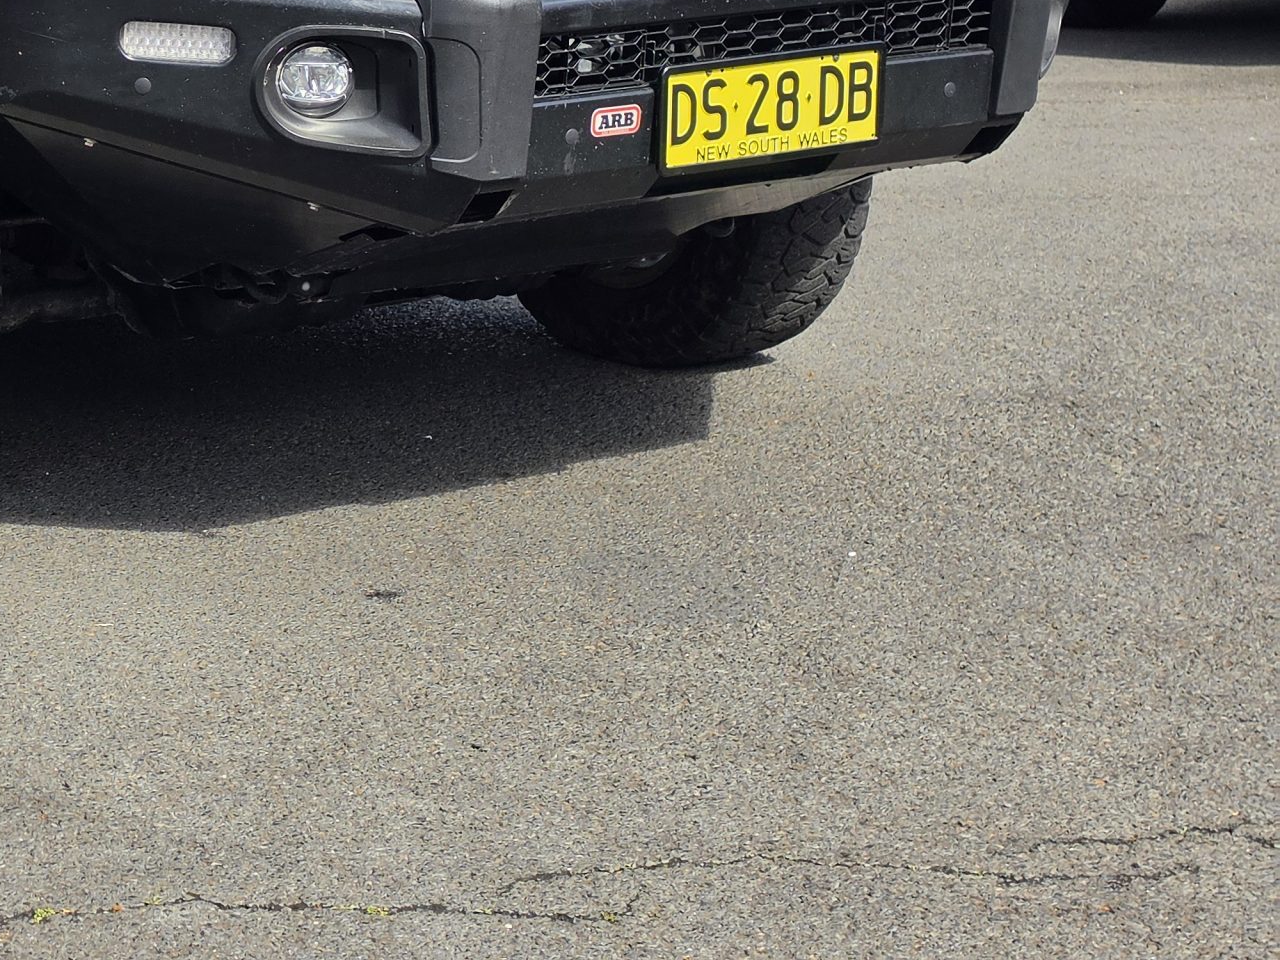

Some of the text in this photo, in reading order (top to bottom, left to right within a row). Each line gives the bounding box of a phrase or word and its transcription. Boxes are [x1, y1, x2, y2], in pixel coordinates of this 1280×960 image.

[598, 112, 635, 130] ARB
[696, 127, 848, 162] NEW SOUTH WALES
